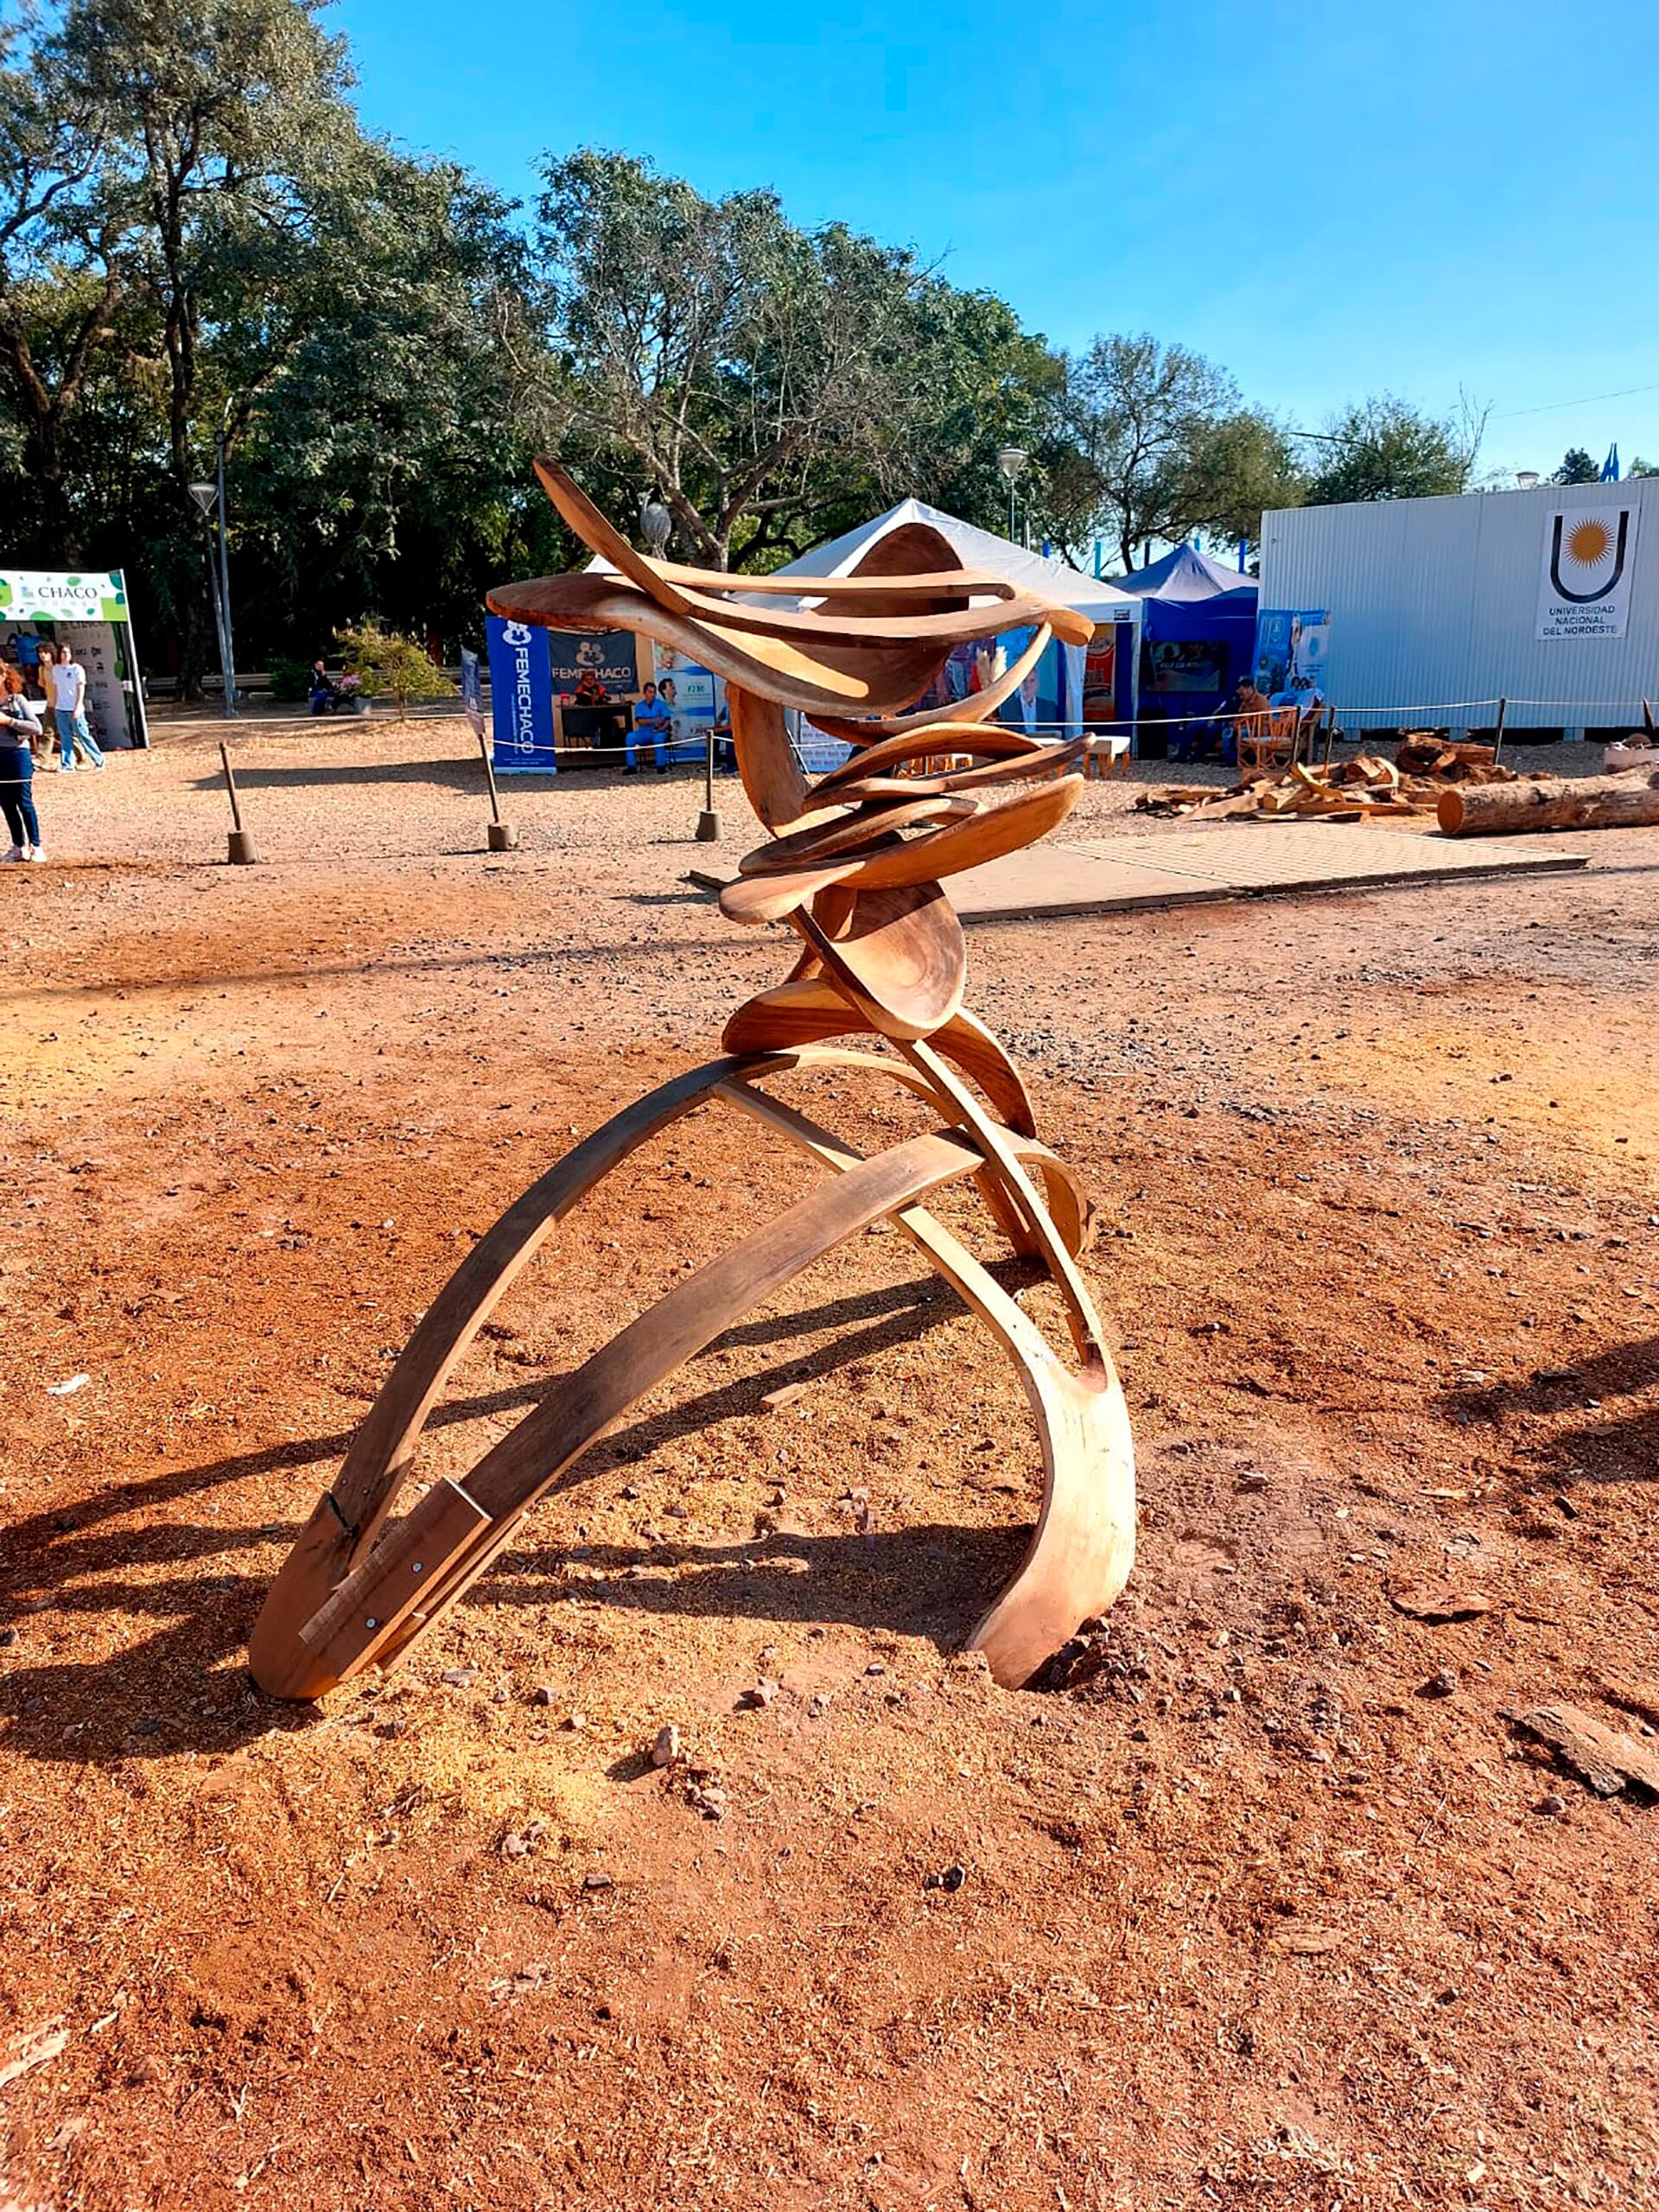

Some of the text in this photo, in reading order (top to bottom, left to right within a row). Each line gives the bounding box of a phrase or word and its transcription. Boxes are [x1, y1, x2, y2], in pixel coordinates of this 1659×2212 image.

[38, 587, 98, 599] CHACO
[1549, 606, 1615, 616] UNIVERSIDAD
[1555, 616, 1605, 626] NACIONAL
[1543, 626, 1618, 635] DEL NORDESTE
[552, 667, 631, 679] FEMEHACO
[516, 648, 534, 754] FEMECHACO
